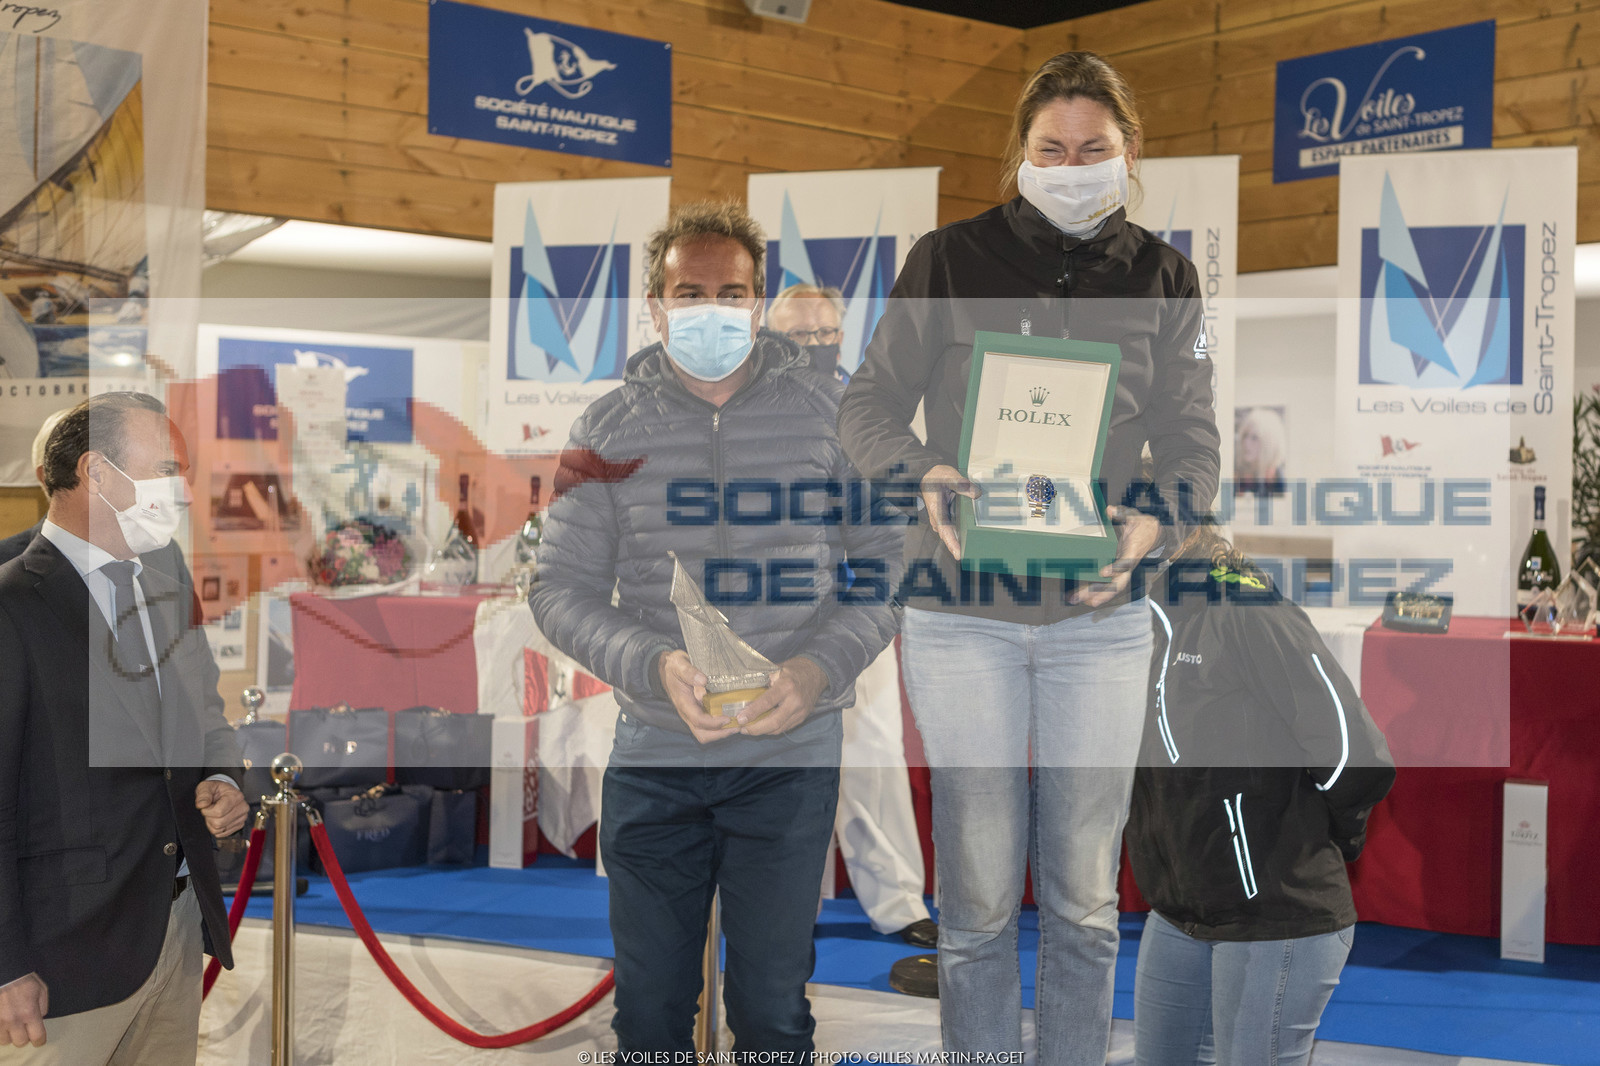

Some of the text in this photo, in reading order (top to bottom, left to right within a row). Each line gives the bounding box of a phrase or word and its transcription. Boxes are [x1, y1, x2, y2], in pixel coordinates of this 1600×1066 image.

[475, 95, 637, 133] SOCIÉTÉ NAUTIQUE
[1373, 106, 1464, 133] SAINT-TROPEZ
[496, 115, 618, 145] SAINT-TROPEZ
[1362, 132, 1451, 154] PARTENAIRES
[1534, 222, 1559, 414] Saint-Tropez
[505, 390, 540, 405] Les
[1357, 396, 1527, 414] Les Voiles de
[997, 407, 1072, 427] ROLEX
